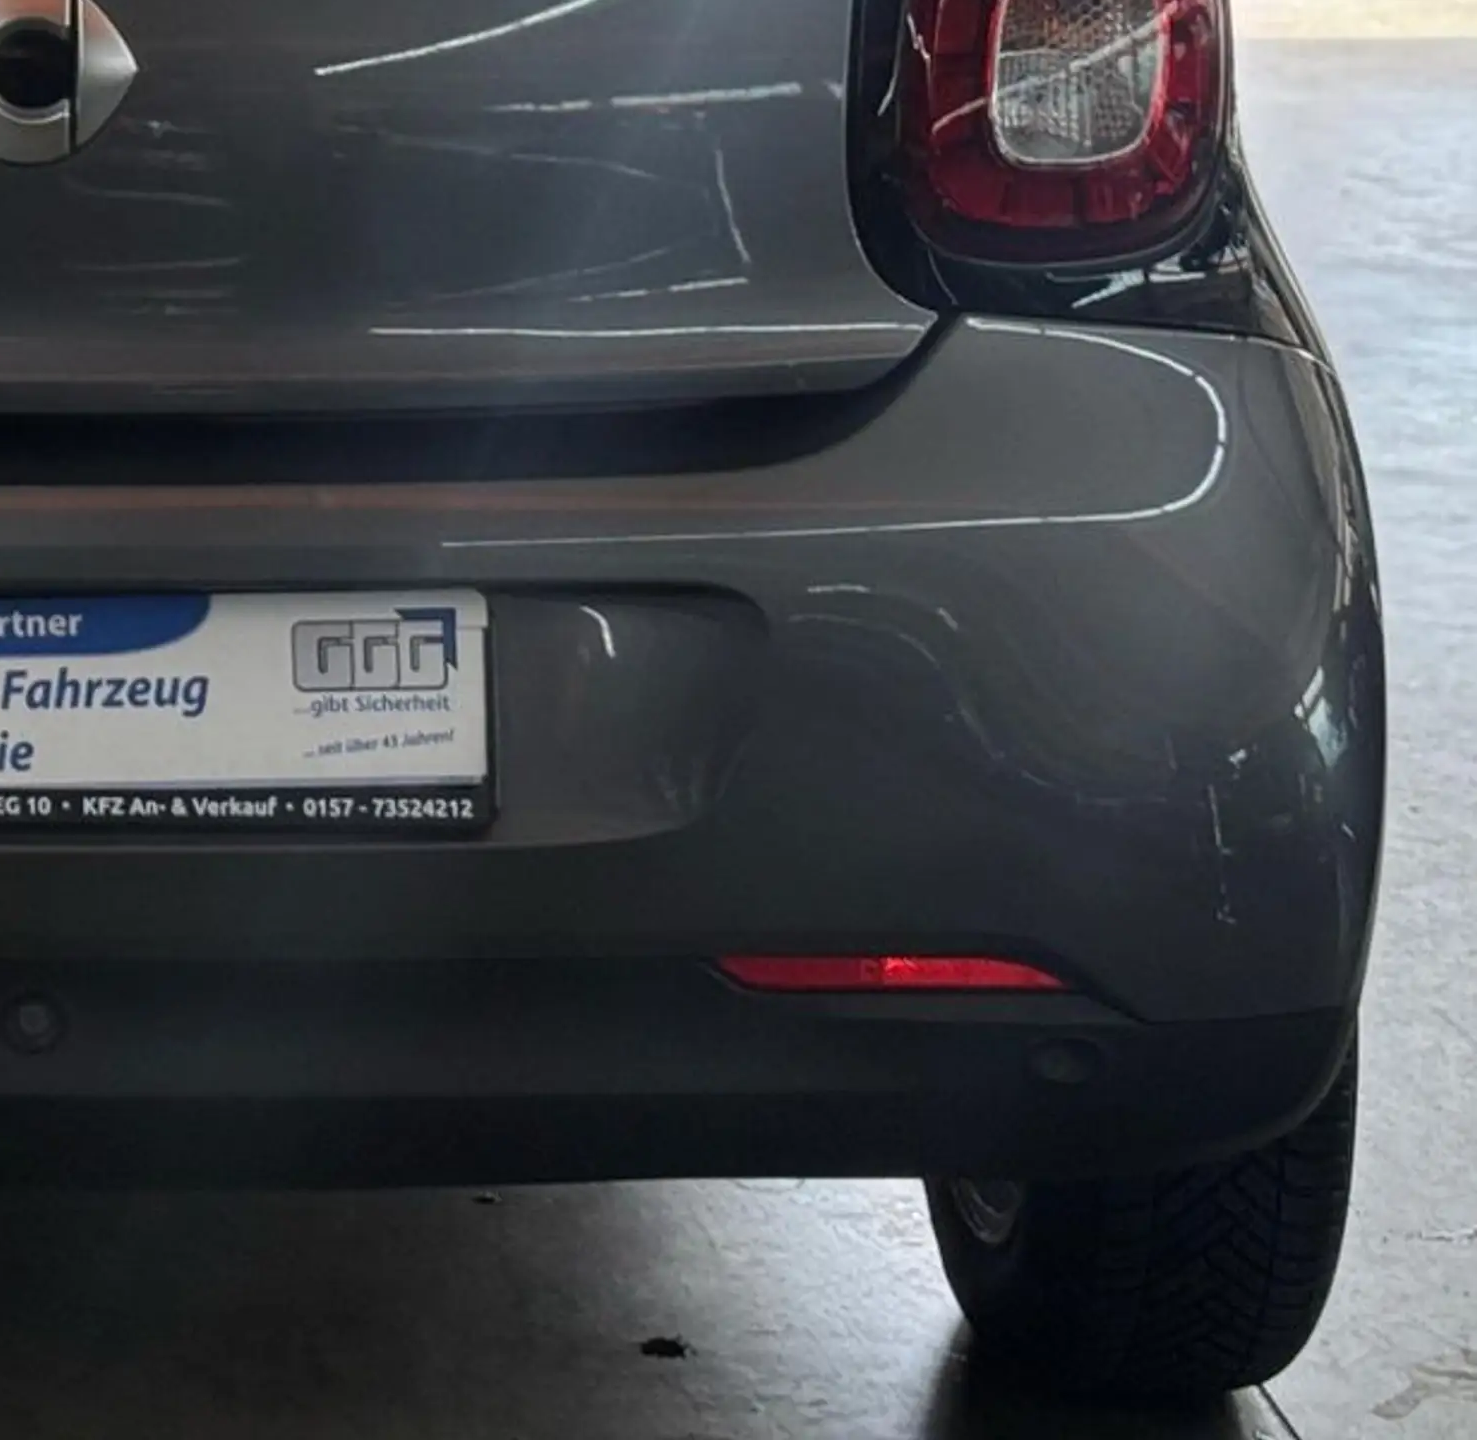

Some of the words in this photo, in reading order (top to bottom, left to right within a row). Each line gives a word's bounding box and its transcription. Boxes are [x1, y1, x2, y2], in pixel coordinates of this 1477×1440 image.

[3, 668, 209, 717] Fahrzeug
[355, 693, 450, 713] Sicherheit
[27, 796, 51, 815] 10
[82, 797, 123, 815] KFZ
[171, 797, 188, 816] &
[192, 796, 277, 816] Verkauf
[303, 797, 353, 818] 0157
[372, 797, 474, 819] 73524212
